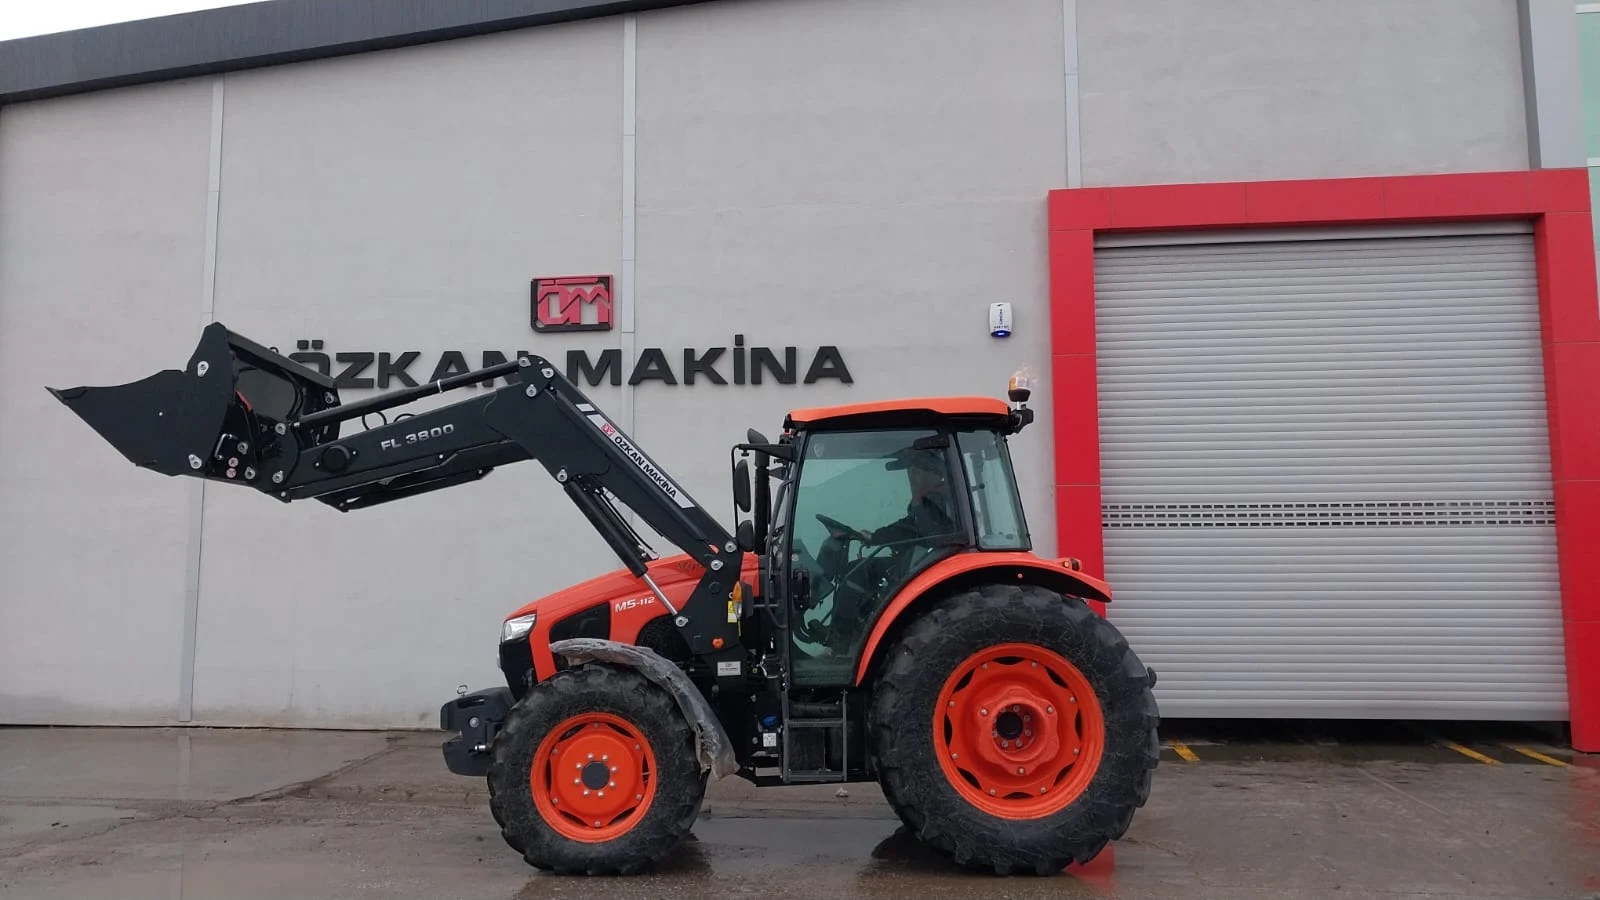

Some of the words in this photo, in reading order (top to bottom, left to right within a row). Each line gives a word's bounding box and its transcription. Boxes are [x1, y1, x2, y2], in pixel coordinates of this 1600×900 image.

[566, 334, 854, 386] MAKİNA
[381, 438, 402, 451] FL
[405, 423, 454, 445] 3800
